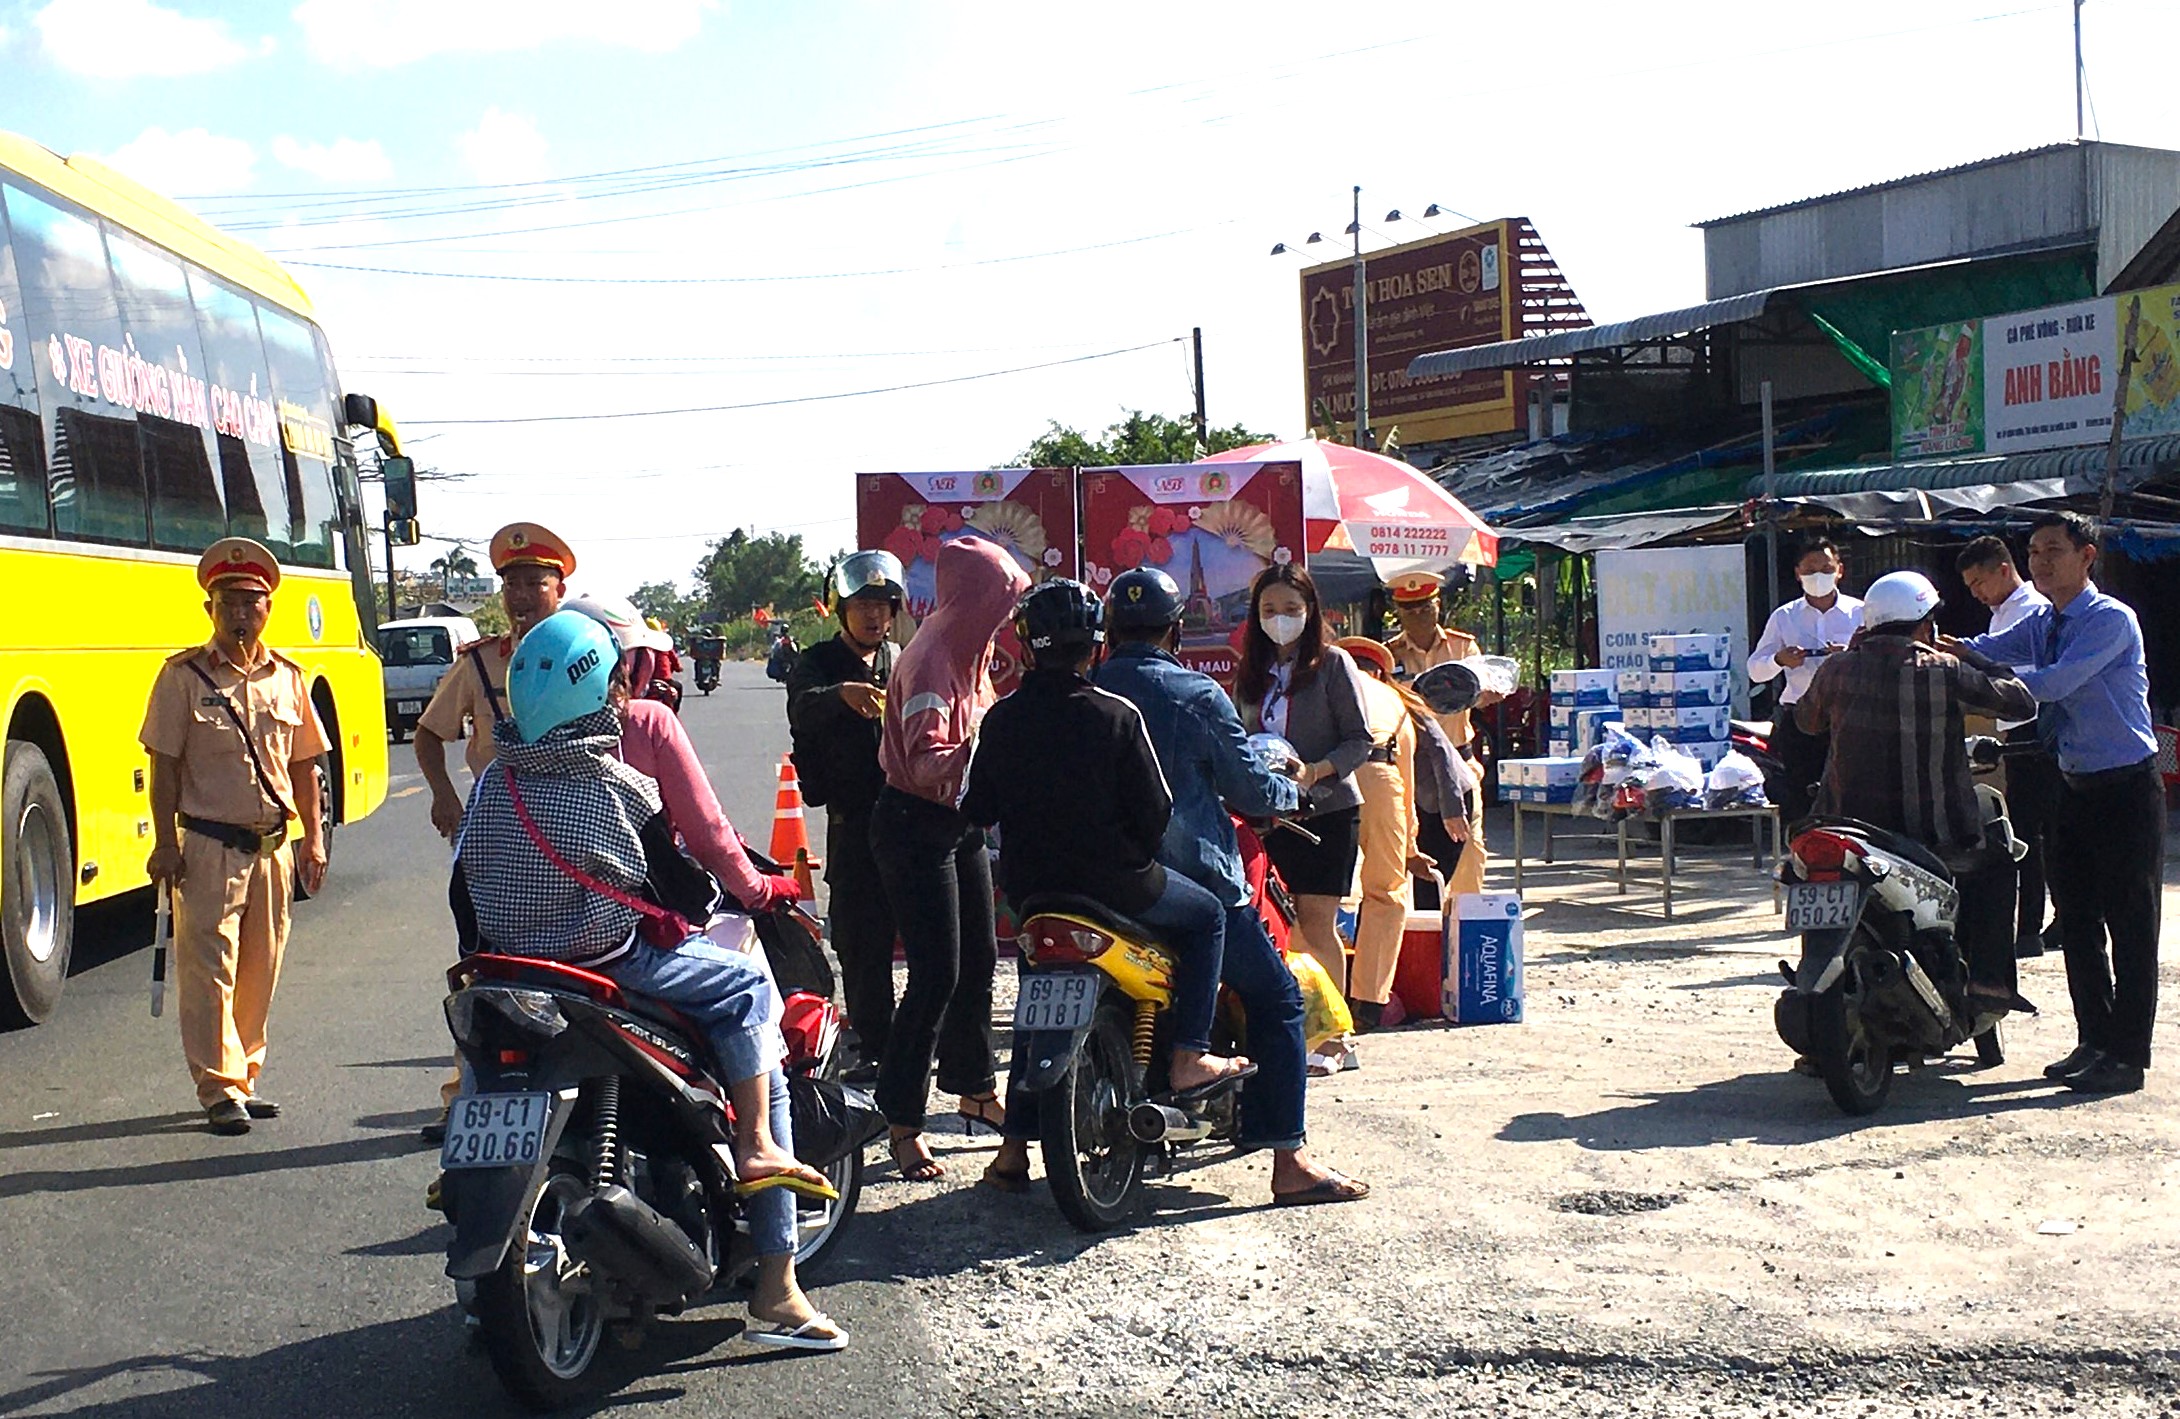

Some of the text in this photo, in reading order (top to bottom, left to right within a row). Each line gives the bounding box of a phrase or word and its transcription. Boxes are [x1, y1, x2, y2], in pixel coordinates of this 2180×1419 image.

[1378, 273, 1414, 302] HOA
[1417, 263, 1454, 294] SEN
[64, 332, 98, 398] XE
[210, 384, 244, 440] CAO
[2004, 363, 2042, 406] ANH
[1371, 526, 1447, 541] 0814 222222
[1370, 542, 1399, 555] 0978
[1404, 544, 1416, 555] 11
[1421, 544, 1449, 556] 7777
[1199, 660, 1231, 672] MAU
[1606, 651, 1643, 669] CHÁO
[1480, 934, 1498, 1006] AQUAFINA
[1030, 978, 1086, 1001] 69-F9
[1025, 1003, 1081, 1026] 0181
[464, 1098, 531, 1129] 69-C1
[448, 1131, 537, 1164] 290.66
